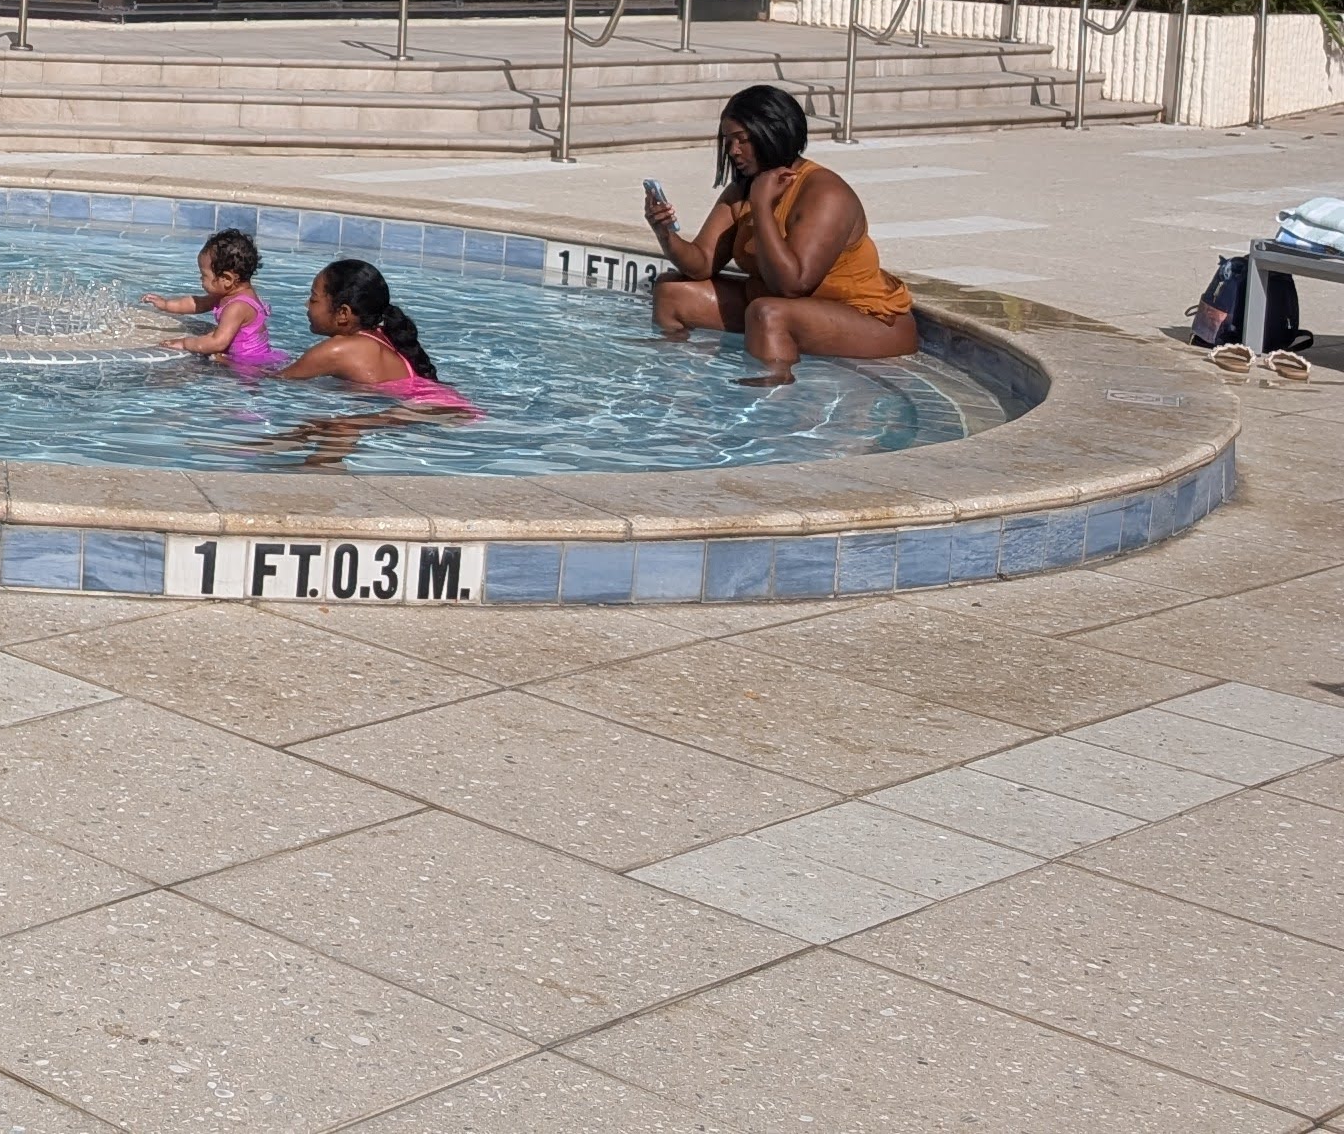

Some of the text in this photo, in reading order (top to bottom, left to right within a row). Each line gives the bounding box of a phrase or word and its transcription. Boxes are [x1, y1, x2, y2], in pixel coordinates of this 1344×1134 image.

[558, 250, 570, 286] 1
[194, 541, 217, 595] 1
[417, 546, 471, 600] M.
